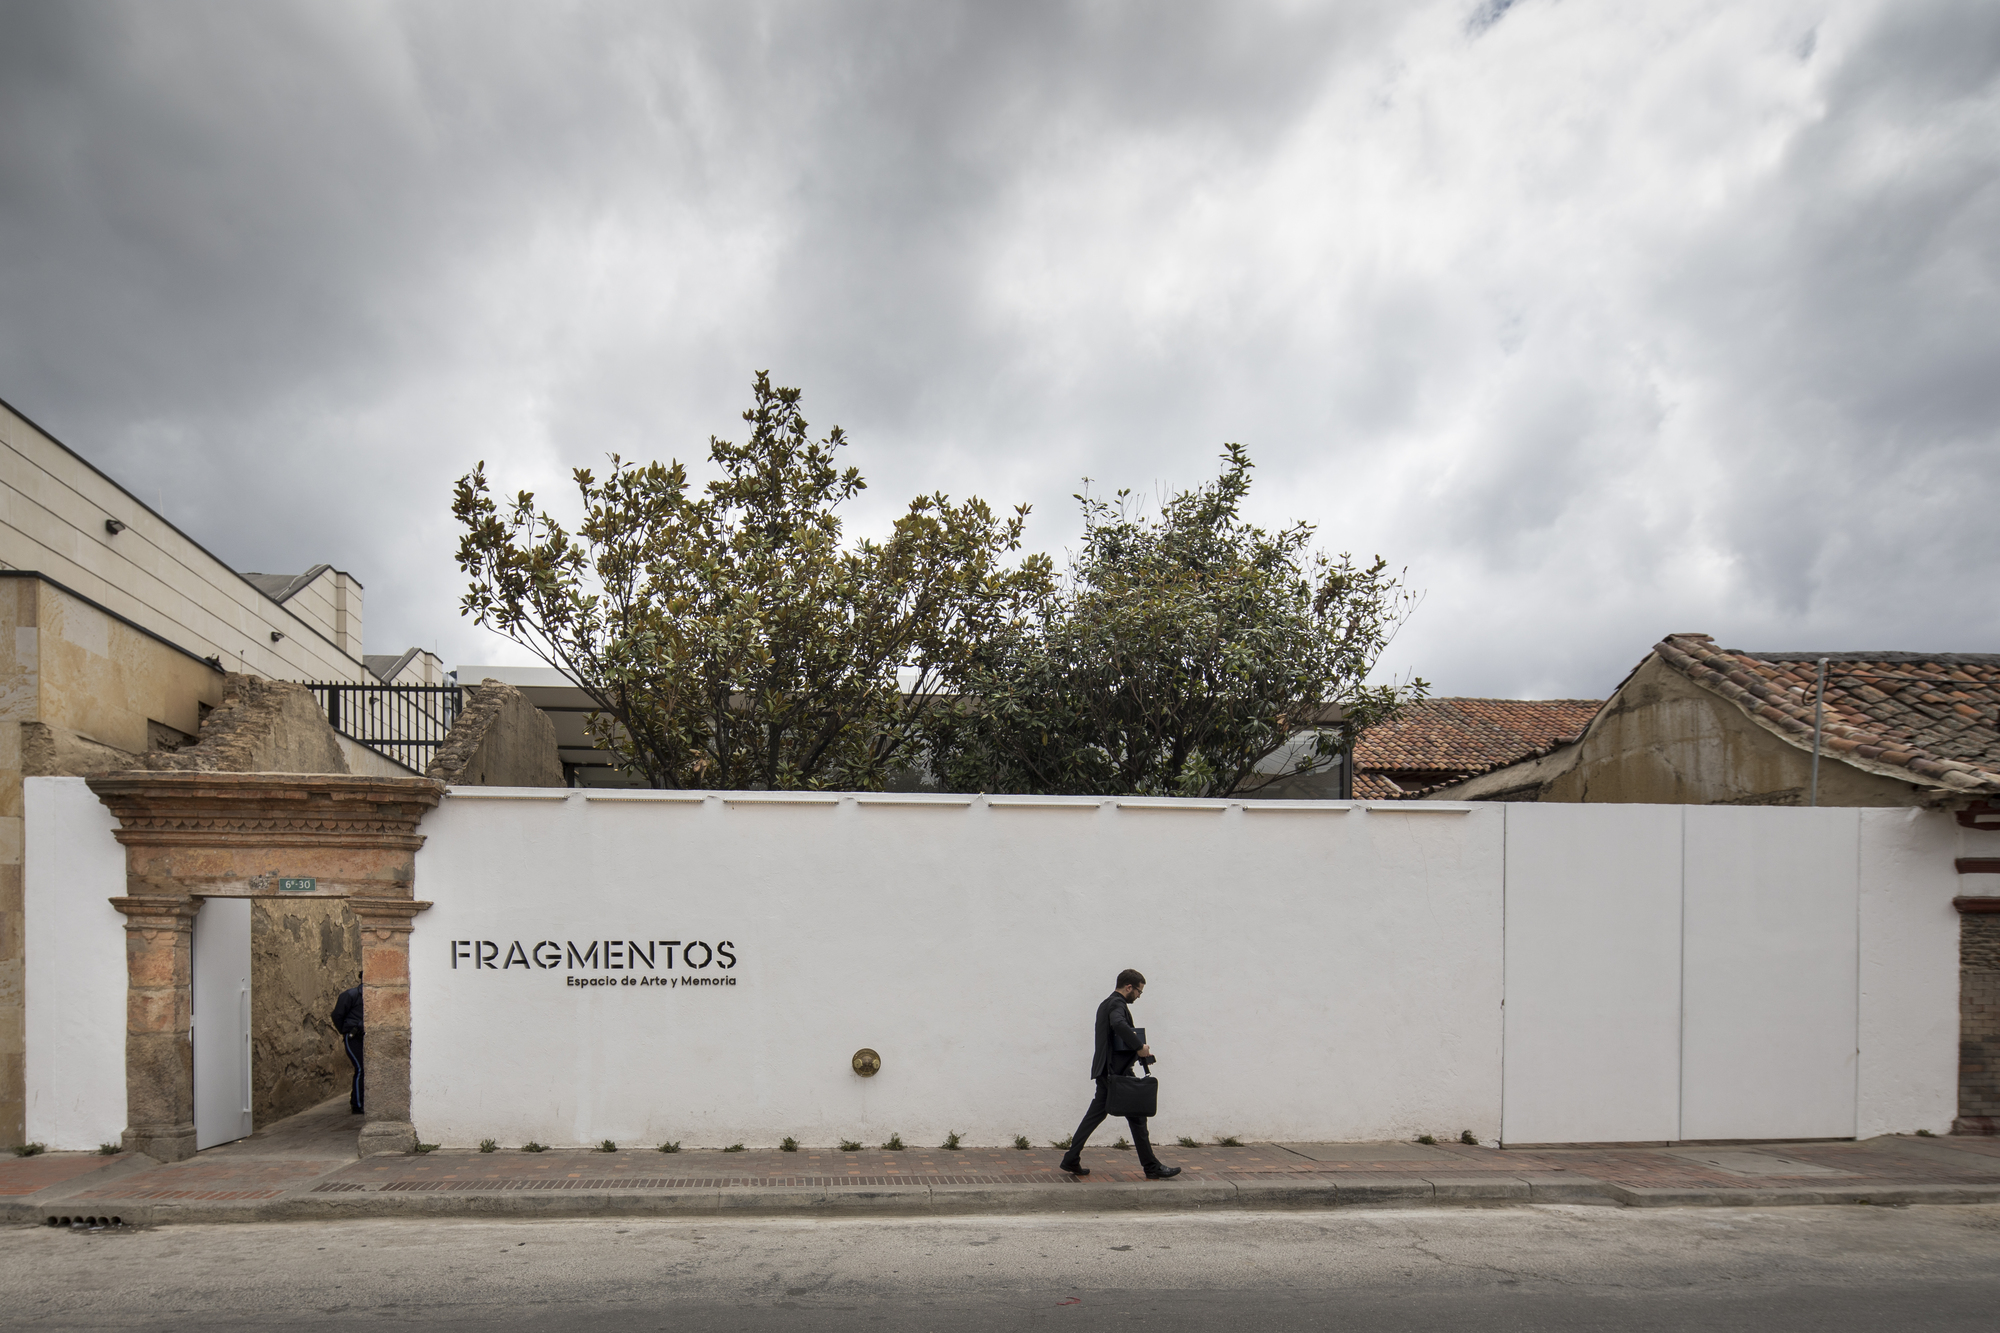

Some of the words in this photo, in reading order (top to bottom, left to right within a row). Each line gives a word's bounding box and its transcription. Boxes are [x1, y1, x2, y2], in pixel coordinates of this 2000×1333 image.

[450, 940, 737, 969] FRAGMENTOS
[566, 975, 617, 988] Espacio
[620, 975, 637, 987] de
[640, 976, 668, 987] Arte
[670, 978, 678, 988] y
[681, 975, 737, 987] Memoria
